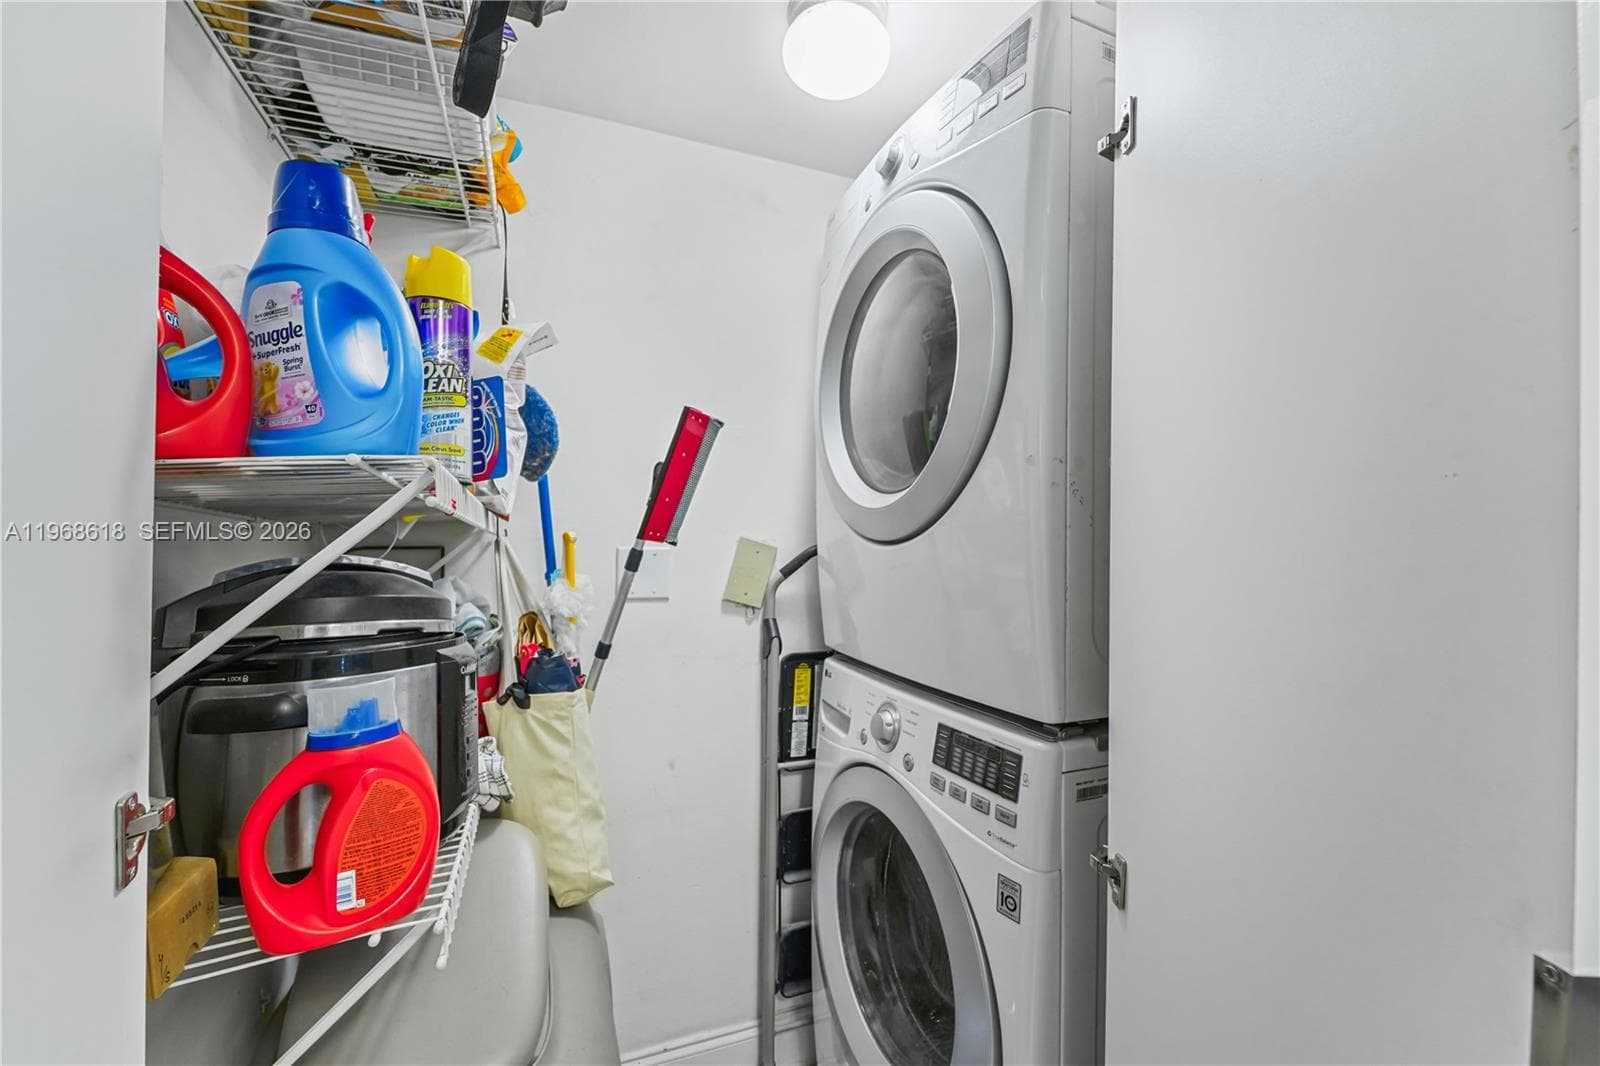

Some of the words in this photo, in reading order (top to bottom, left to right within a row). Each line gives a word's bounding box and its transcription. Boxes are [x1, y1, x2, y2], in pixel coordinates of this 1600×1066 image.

[248, 321, 303, 348] Snuggle
[282, 357, 304, 366] Spring
[284, 363, 302, 372] Burst
[424, 378, 464, 393] EAN
[307, 405, 316, 413] 40
[433, 412, 460, 420] CHANGES
[426, 419, 447, 429] COLOR
